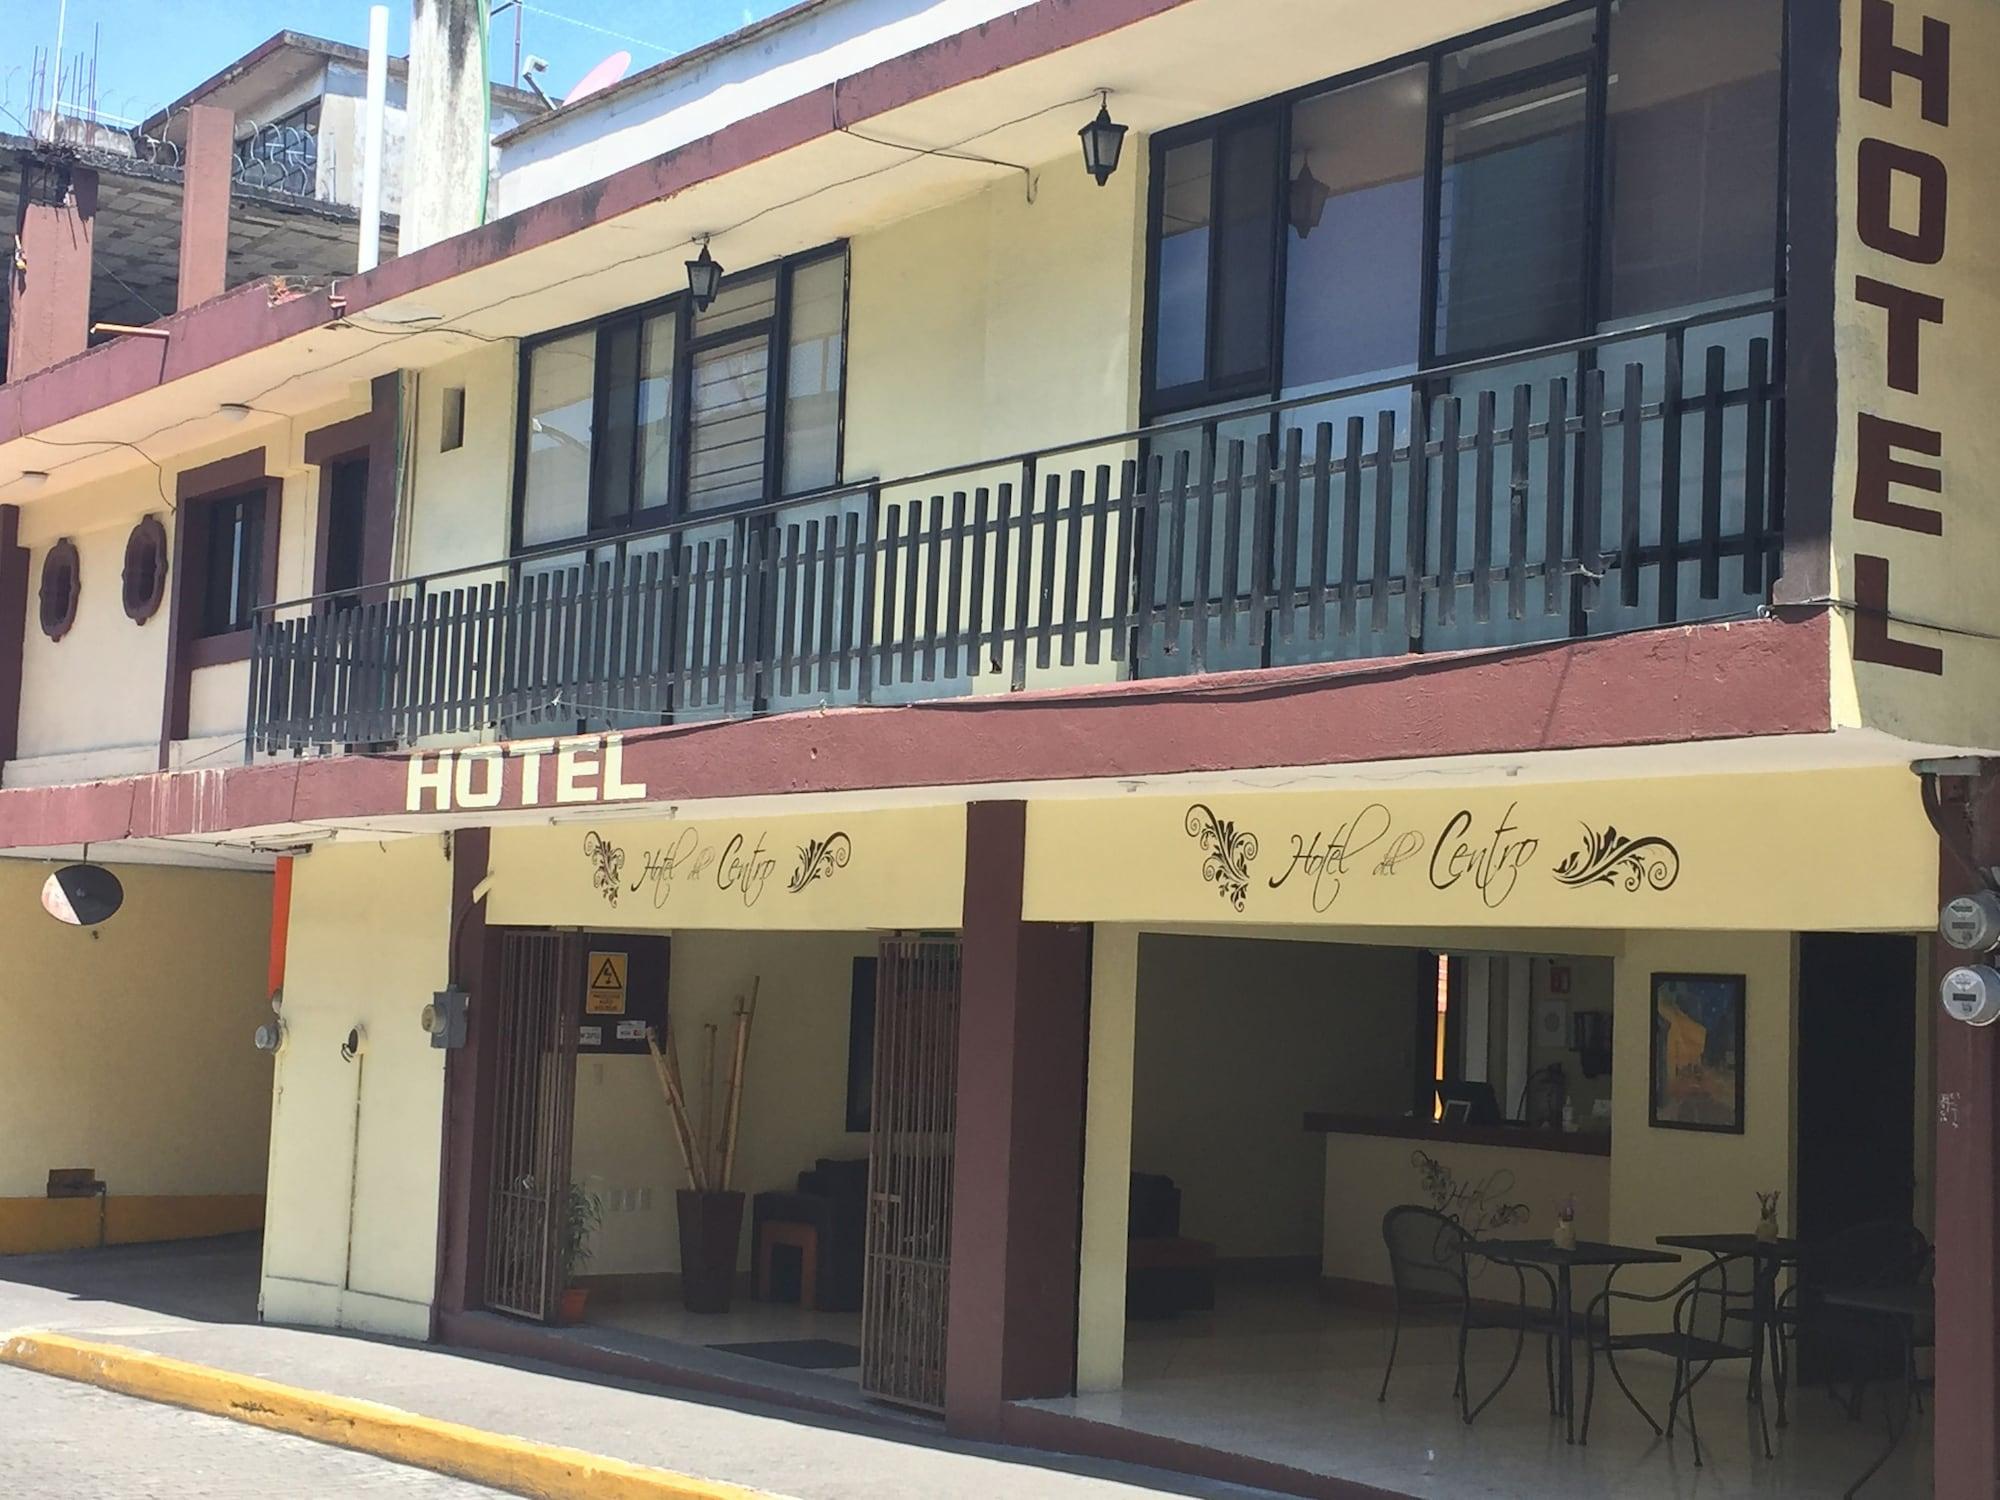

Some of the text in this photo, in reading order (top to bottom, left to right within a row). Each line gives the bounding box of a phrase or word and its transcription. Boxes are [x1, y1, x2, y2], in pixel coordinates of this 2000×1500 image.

[1852, 0, 1950, 676] HOTEL
[406, 735, 647, 811] HOTEL
[631, 827, 698, 909] Hotel
[717, 832, 776, 907] Centro
[1269, 801, 1538, 912] Hotel del Centro
